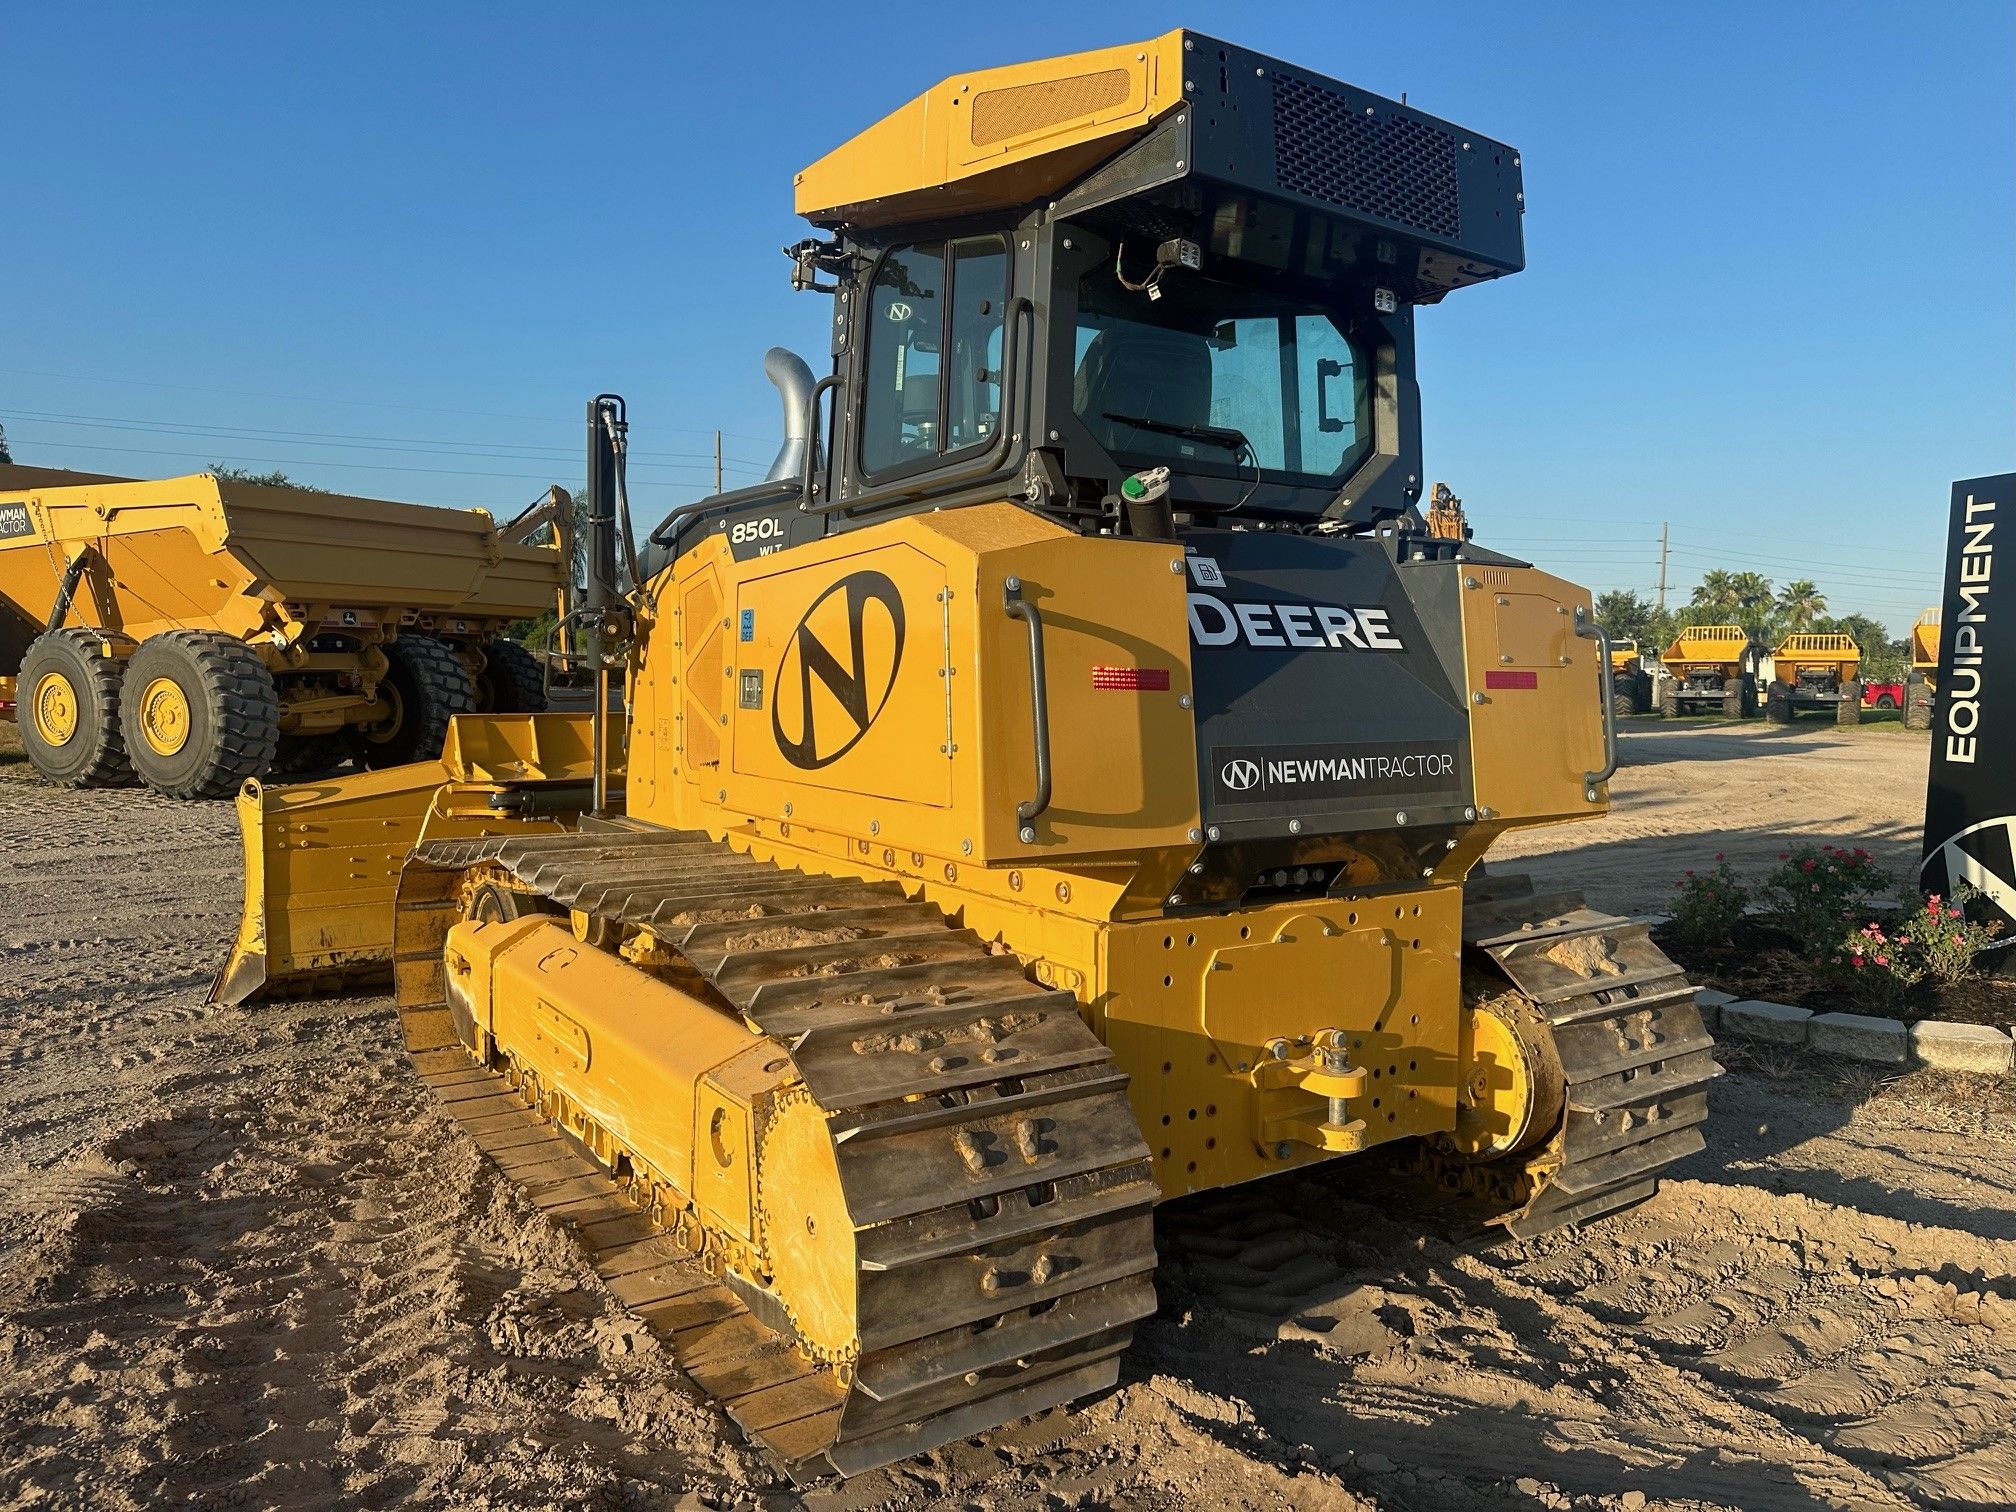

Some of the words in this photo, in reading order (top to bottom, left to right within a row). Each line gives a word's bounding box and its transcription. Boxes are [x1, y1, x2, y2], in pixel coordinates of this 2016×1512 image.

[731, 518, 784, 544] 850L
[1187, 592, 1403, 650] DEERE
[1946, 495, 1996, 764] EQUIPMENT
